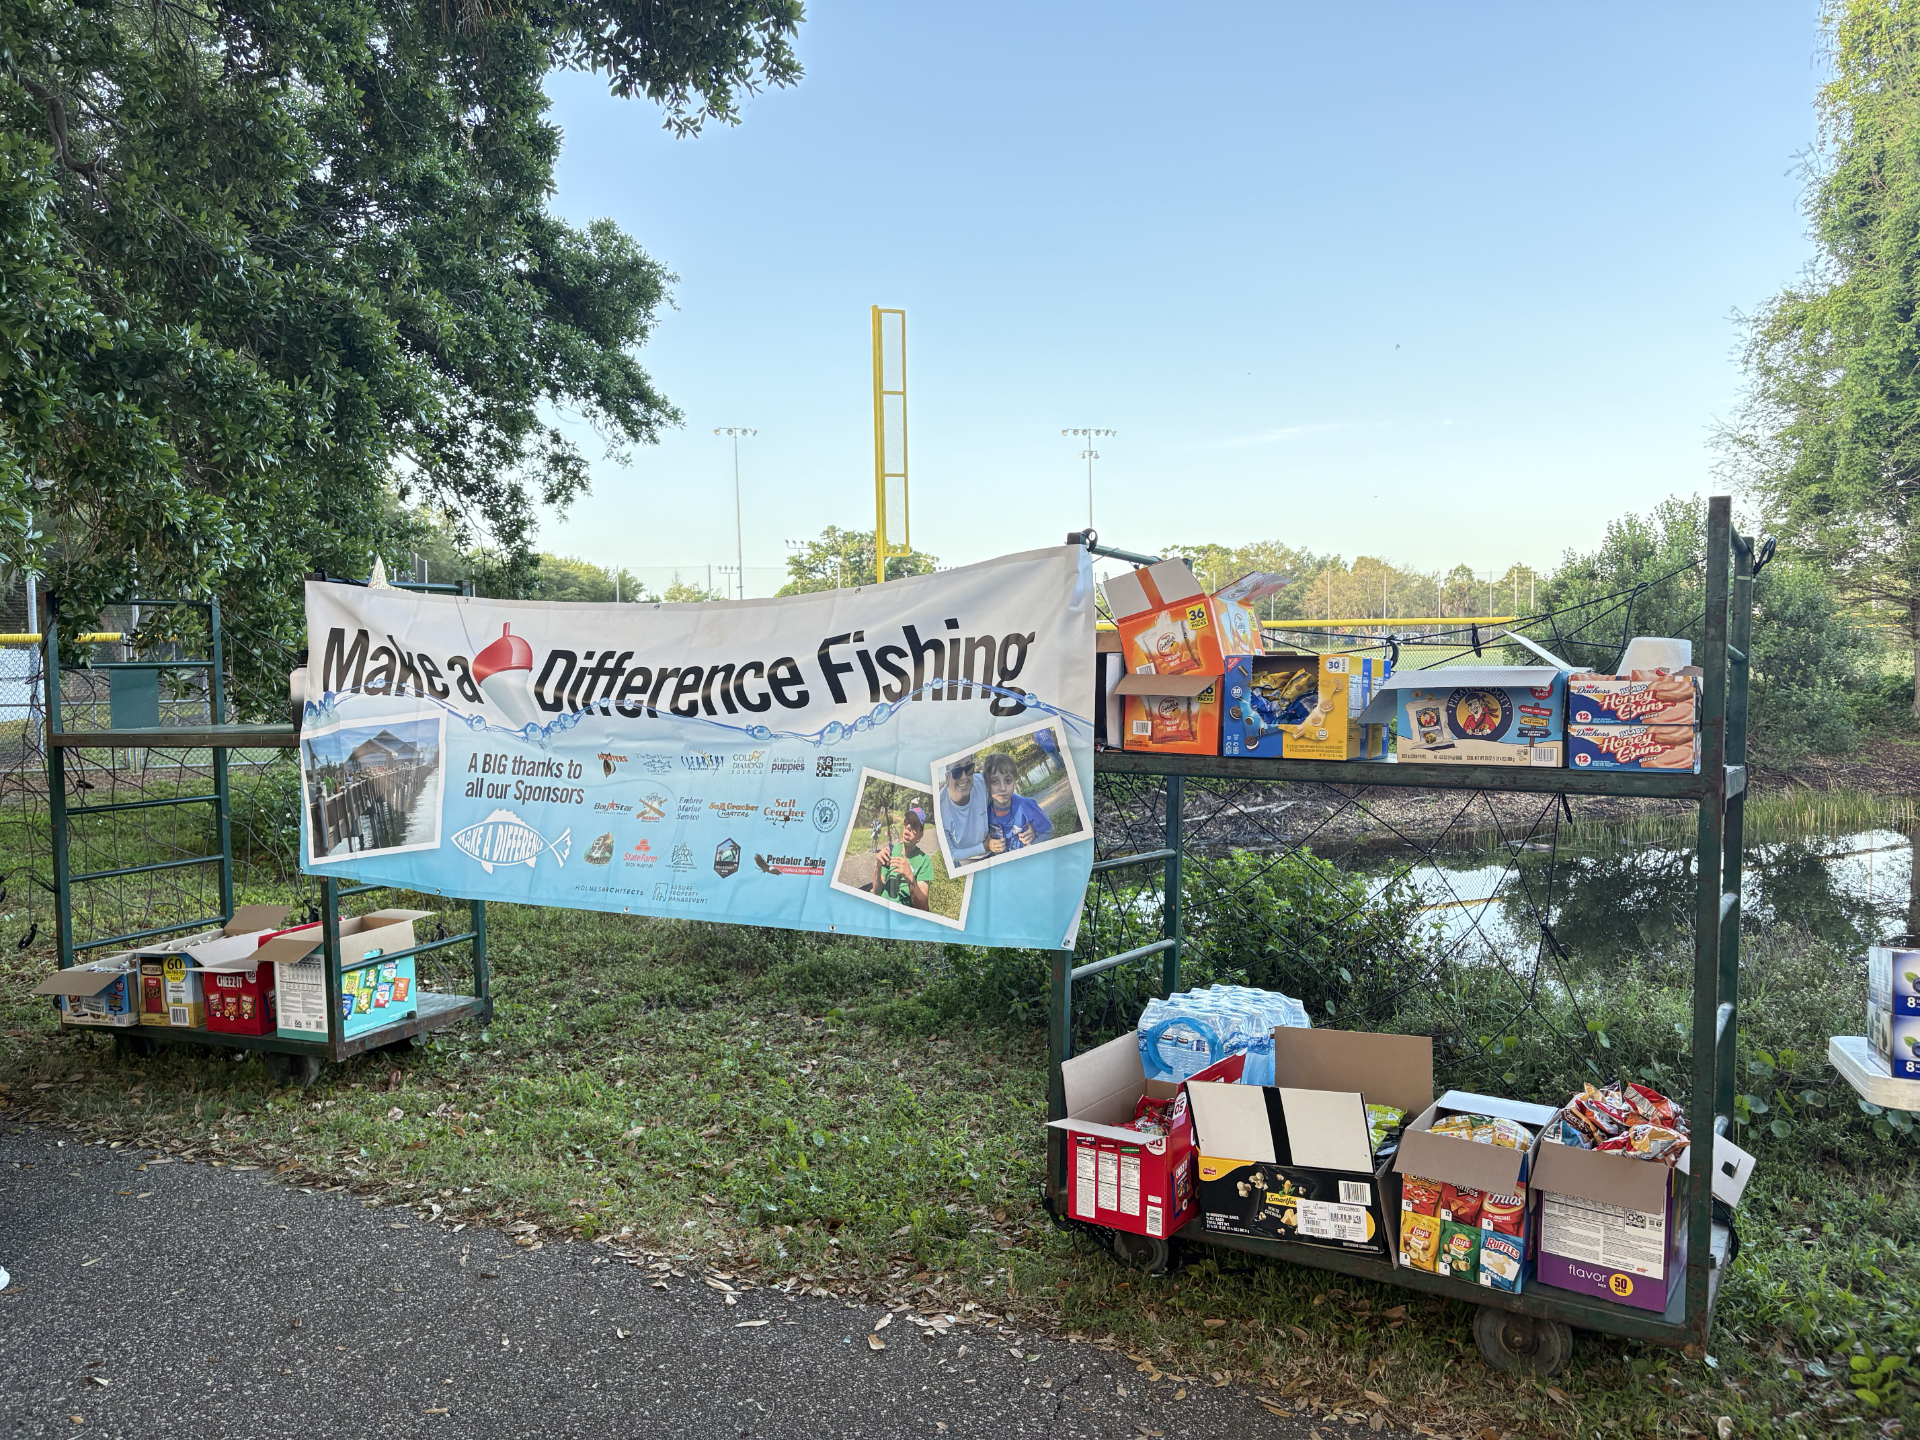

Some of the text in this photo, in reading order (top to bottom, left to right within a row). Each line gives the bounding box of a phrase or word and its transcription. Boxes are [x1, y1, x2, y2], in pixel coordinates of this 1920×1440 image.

[1188, 607, 1205, 621] 36
[323, 617, 1036, 719] Make a Difference Fishing
[1328, 661, 1340, 669] 30
[1576, 685, 1611, 694] Duchess
[1620, 684, 1648, 695] JUMBO
[1599, 690, 1657, 710] Honey
[1578, 712, 1590, 720] 12
[1617, 702, 1666, 720] Buns
[1575, 727, 1610, 737] Duchess
[1619, 727, 1647, 738] JUMBO
[1598, 733, 1656, 752] Honey
[597, 753, 628, 763] HOOTERS
[732, 753, 753, 762] GOLD
[1577, 755, 1589, 763] 12
[1616, 744, 1665, 763] Buns
[467, 752, 583, 779] A BIG thanks to
[771, 762, 805, 774] puppies
[464, 777, 585, 806] all our Sponsors
[679, 796, 703, 805] Embree
[774, 798, 797, 808] Salt
[593, 802, 634, 812] Bay Star
[677, 804, 702, 812] Marine
[709, 802, 759, 811] Salt Cracker
[763, 807, 807, 817] Cracker
[676, 812, 700, 821] Service
[457, 823, 544, 862] MAKE A DIFFERENCE
[766, 854, 827, 869] Predator Eagle
[668, 896, 709, 904] MANAGEMENT
[167, 958, 182, 969] 60
[1906, 996, 1916, 1009] 8
[1905, 1061, 1915, 1073] 8
[1268, 1194, 1297, 1206] Smartfoo
[1412, 1226, 1430, 1239] Lay's
[1452, 1236, 1471, 1249] Lay's
[1485, 1237, 1521, 1260] RUFFLES
[1568, 1264, 1607, 1282] flavor
[1614, 1276, 1628, 1287] 50
